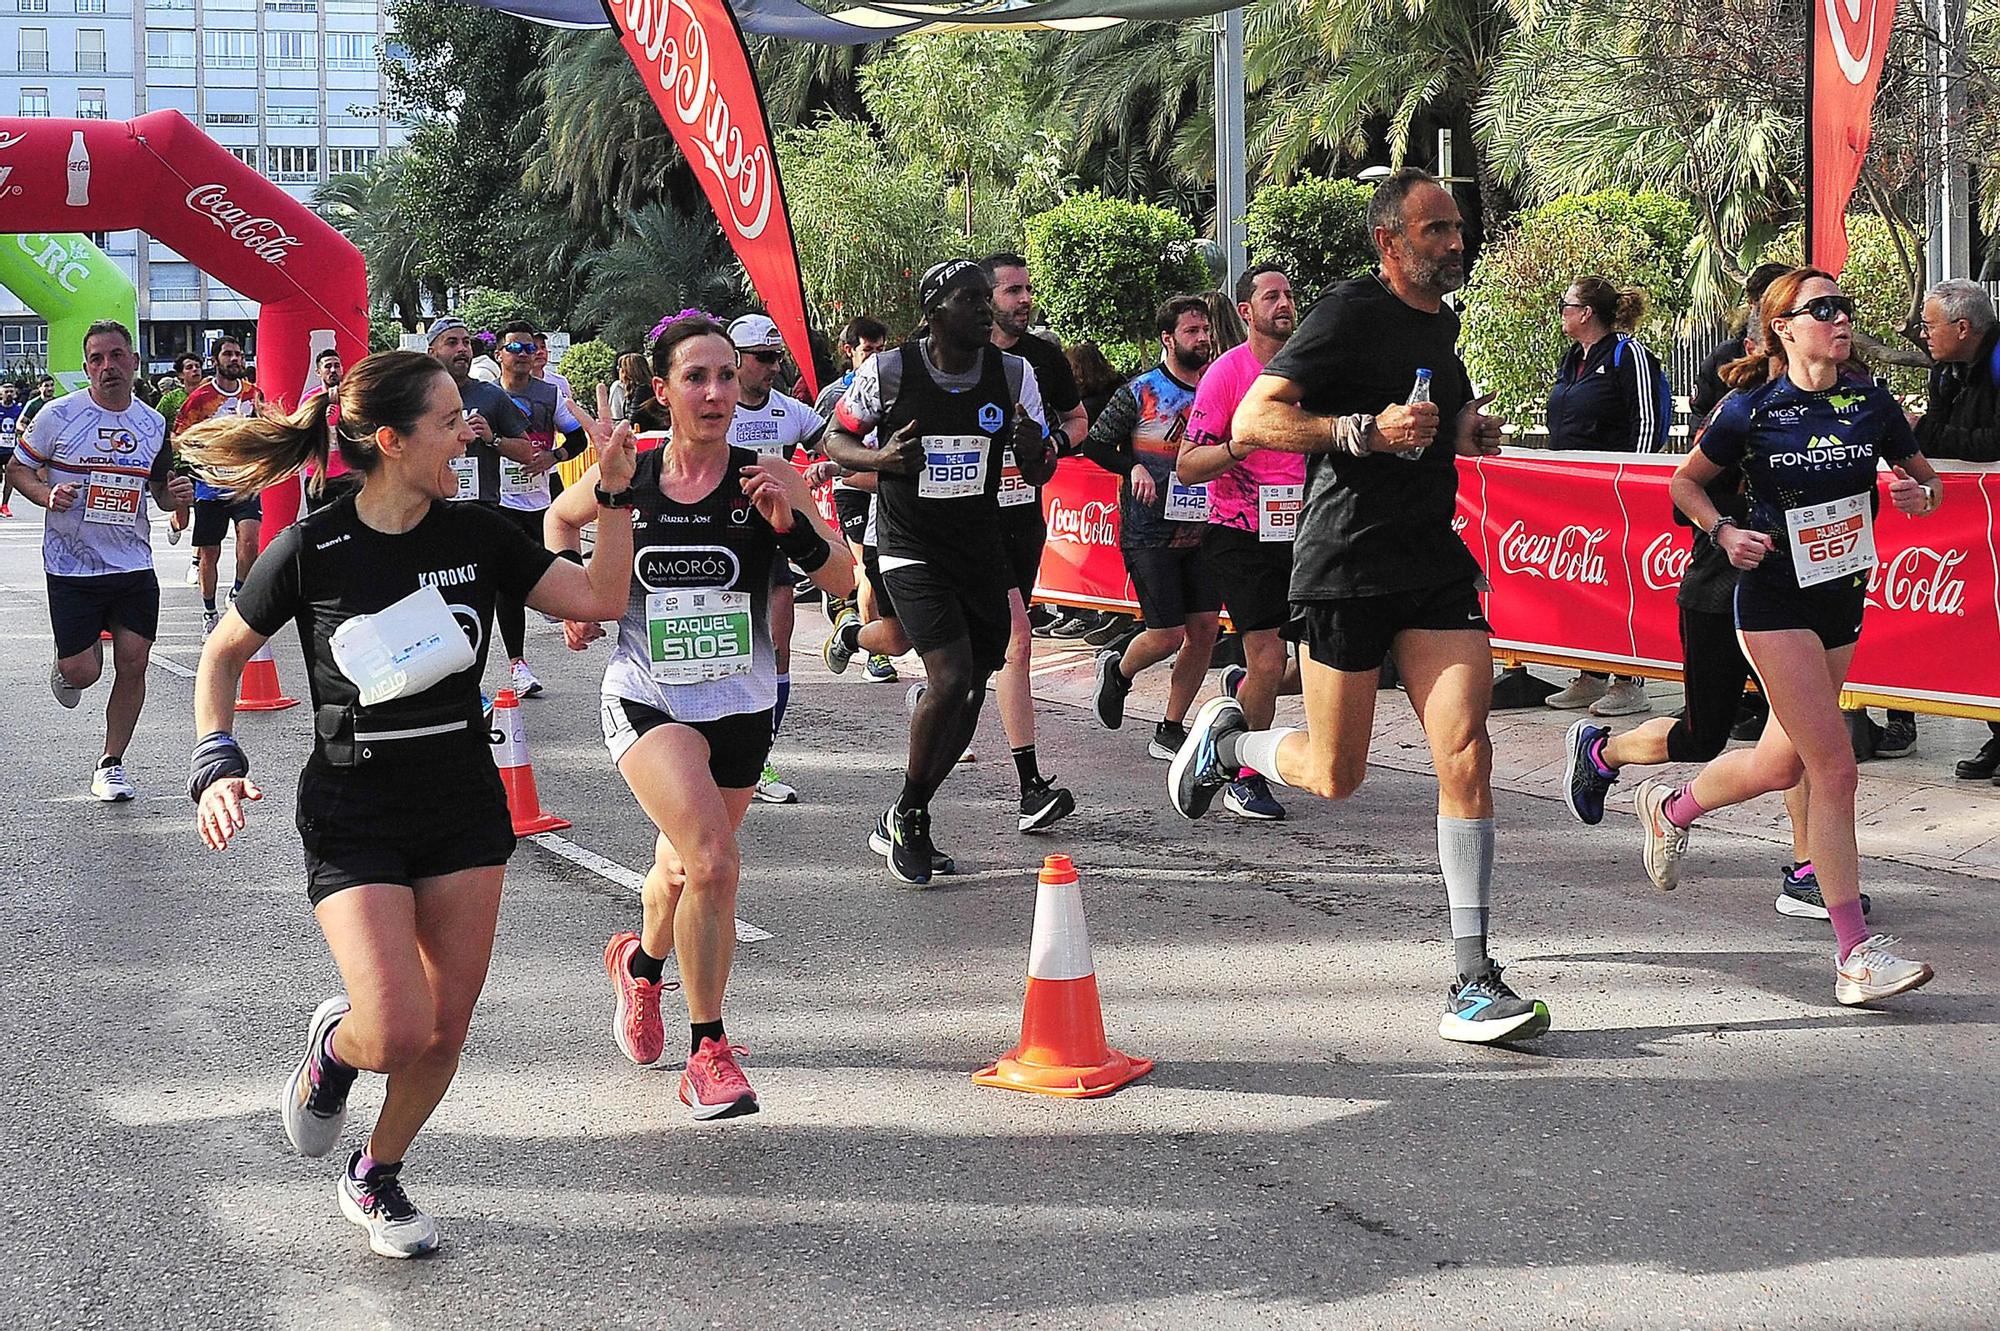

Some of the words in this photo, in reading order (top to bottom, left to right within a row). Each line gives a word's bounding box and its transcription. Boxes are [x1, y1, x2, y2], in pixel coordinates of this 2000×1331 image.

[186, 184, 303, 266] Coca-Cola
[1768, 408, 1796, 418] MGS
[79, 456, 115, 465] MEDIA
[1769, 443, 1873, 468] FONDISTAS
[928, 465, 978, 481] 1980
[1804, 461, 1854, 471] YECLA
[100, 487, 130, 498] VICENT
[1173, 495, 1206, 508] 1442
[94, 497, 132, 512] 5214
[1046, 498, 1118, 544] Coca-Cola
[1499, 520, 1611, 584] Coca-Cola
[1809, 533, 1858, 562] 667
[647, 556, 726, 575] AMORÓS
[418, 564, 476, 588] KOROKO
[665, 616, 734, 635] RAQUEL
[663, 633, 739, 660] 5105
